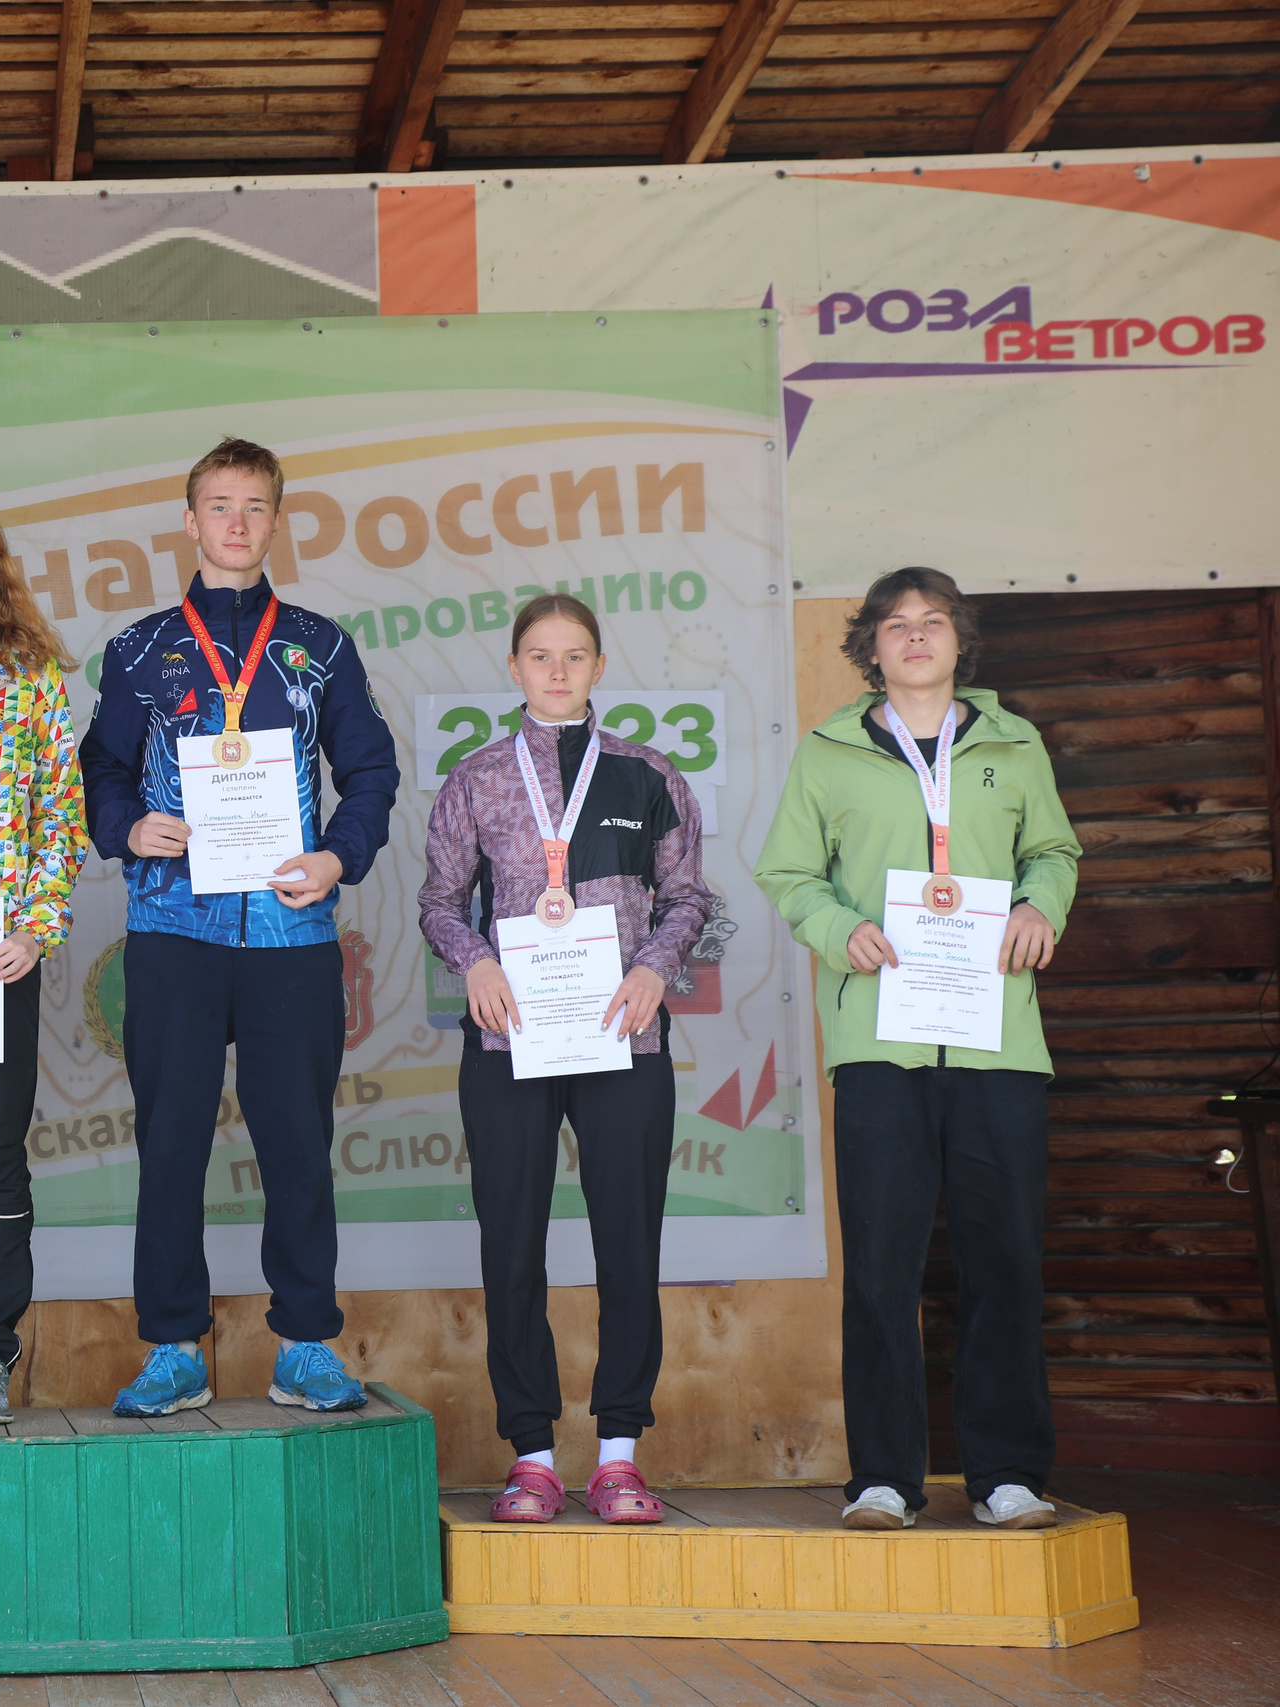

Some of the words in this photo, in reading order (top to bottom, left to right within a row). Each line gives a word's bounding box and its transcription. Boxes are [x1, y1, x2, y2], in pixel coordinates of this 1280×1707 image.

[818, 286, 1031, 336] РОЗА
[984, 314, 1266, 362] ВЕТРОВ
[161, 665, 191, 680] DINA
[211, 770, 267, 785] ДИПЛОМ
[611, 816, 643, 830] TERREX
[916, 915, 975, 930] ДИПЛОМ
[530, 949, 588, 964] ДИПЛОМ
[549, 963, 581, 971] степень
